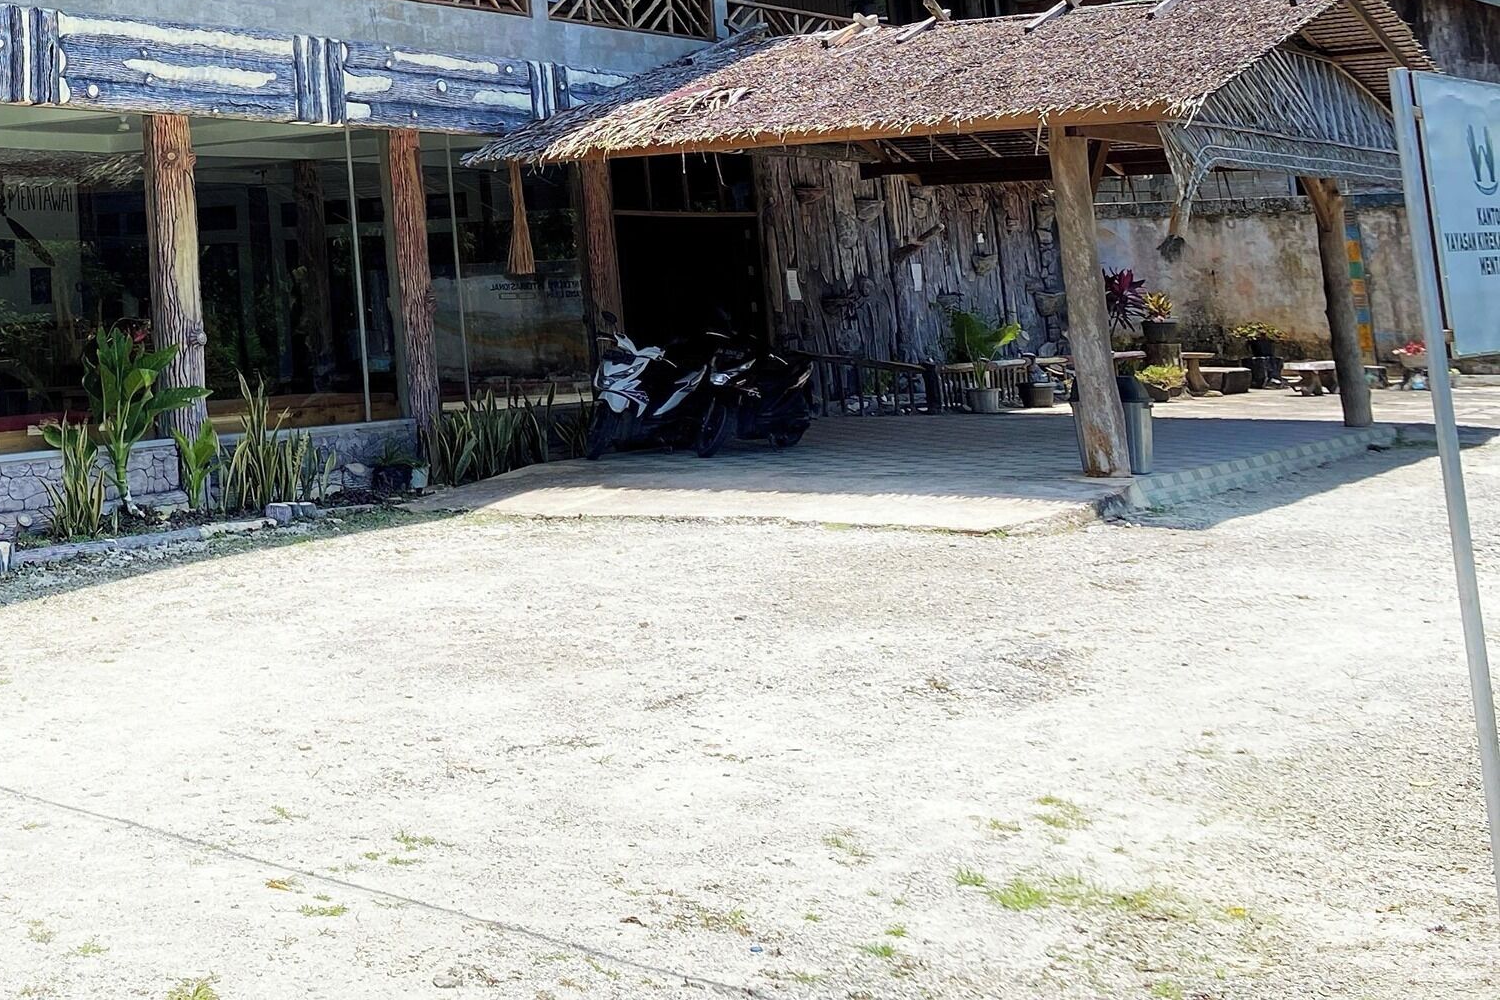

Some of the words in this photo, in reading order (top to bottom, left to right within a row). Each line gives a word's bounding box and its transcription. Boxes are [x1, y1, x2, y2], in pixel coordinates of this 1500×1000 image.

[8, 184, 74, 213] MENTAWAI
[1444, 232, 1477, 252] YAYASAN
[1479, 256, 1500, 276] MENT
